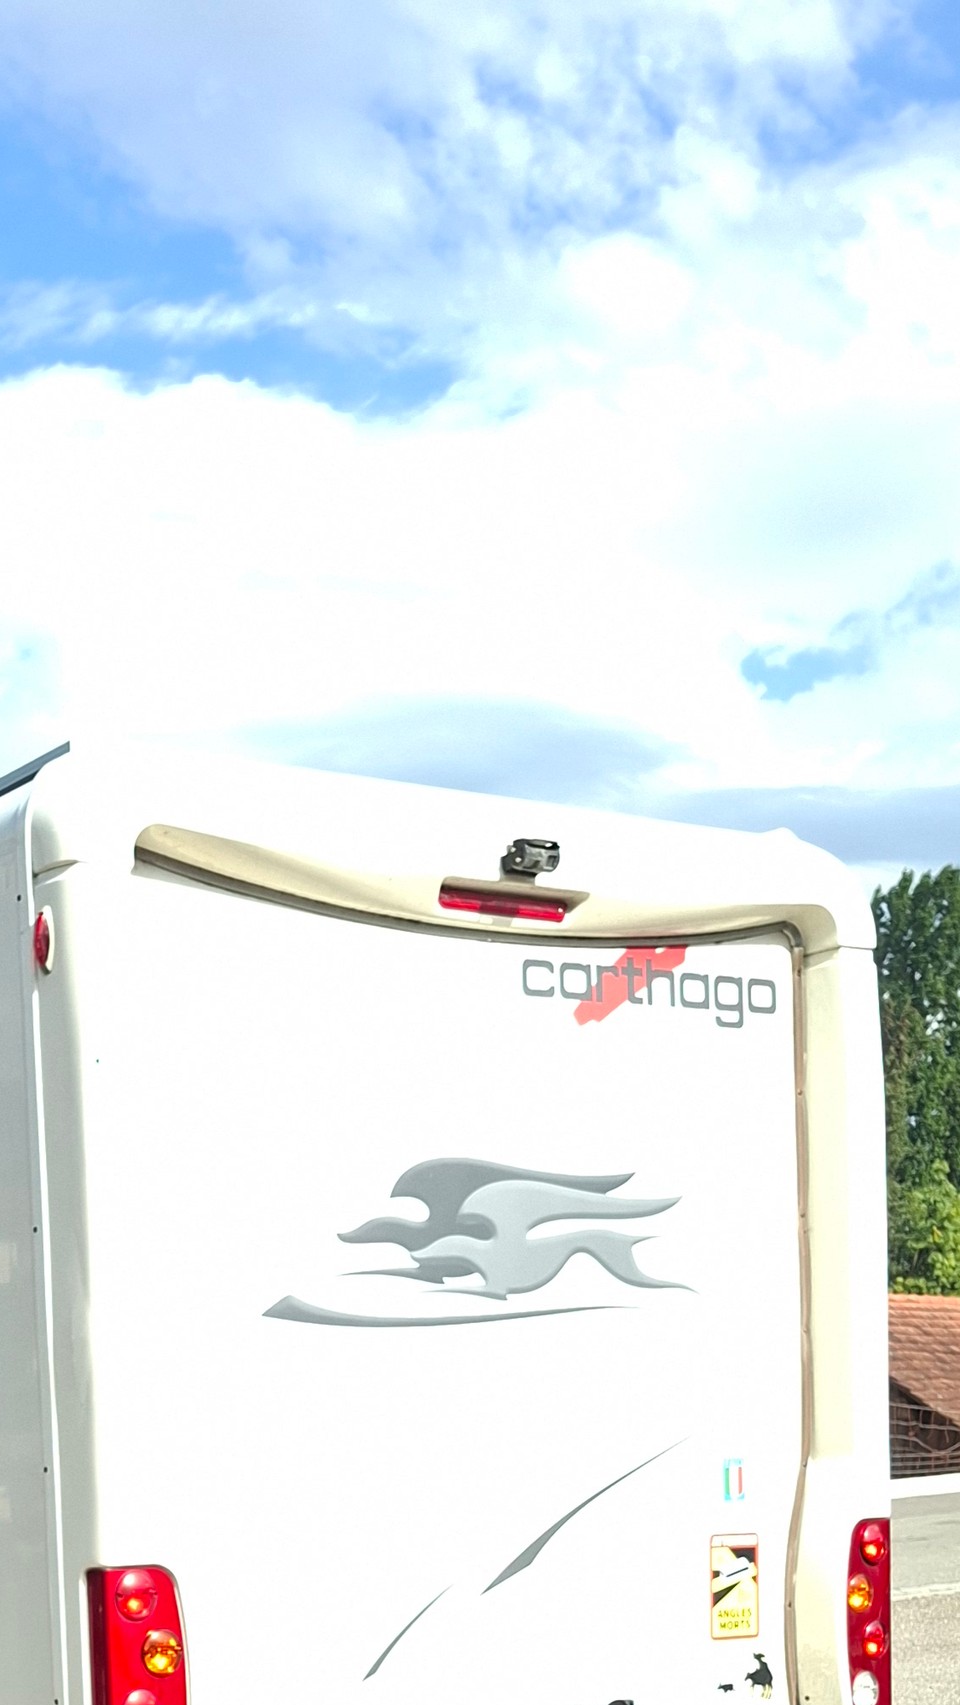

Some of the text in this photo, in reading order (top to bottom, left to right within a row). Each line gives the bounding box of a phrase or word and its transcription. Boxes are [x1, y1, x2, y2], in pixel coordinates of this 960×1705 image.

[522, 956, 777, 1029] carthago
[718, 1608, 752, 1618] ANGLES
[720, 1620, 751, 1630] MORTS
